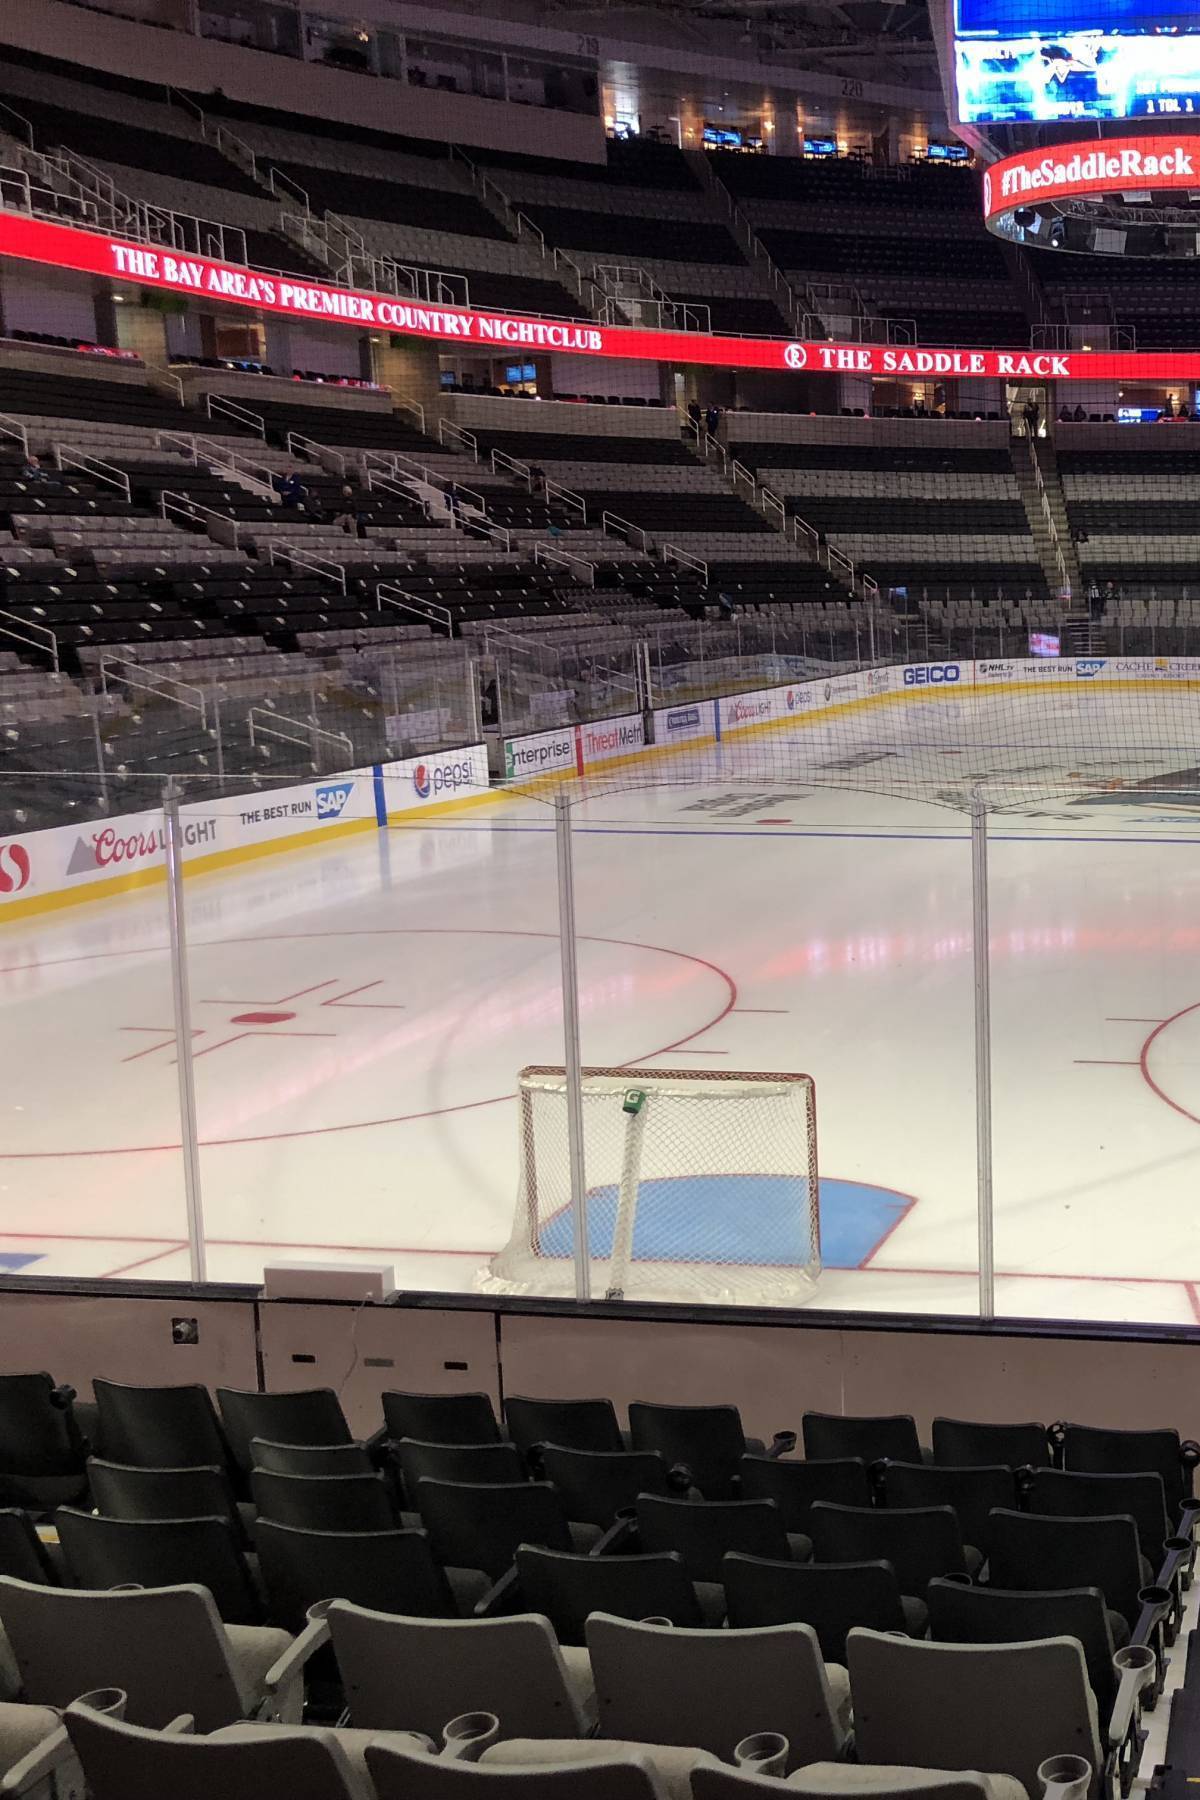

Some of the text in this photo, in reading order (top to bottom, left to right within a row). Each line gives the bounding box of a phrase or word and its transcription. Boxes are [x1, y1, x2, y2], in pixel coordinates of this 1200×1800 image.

[1002, 148, 1194, 197] #TheSaddleRack
[111, 244, 604, 351] THE BAY AREA'S PREMIER COUNTRY NIGHTCLUB
[820, 348, 873, 370] THE
[883, 352, 986, 373] SADDLE
[998, 353, 1071, 376] RACK
[903, 665, 960, 685] GEICO
[1023, 665, 1073, 674] THE BEST RUN
[1076, 662, 1102, 676] SAP
[1116, 663, 1155, 672] CACHE
[586, 723, 643, 754] ThreatMetri
[434, 757, 473, 796] pepsi
[240, 801, 312, 825] THE BEST RUN
[317, 788, 349, 815] SAP
[93, 827, 159, 866] Coors
